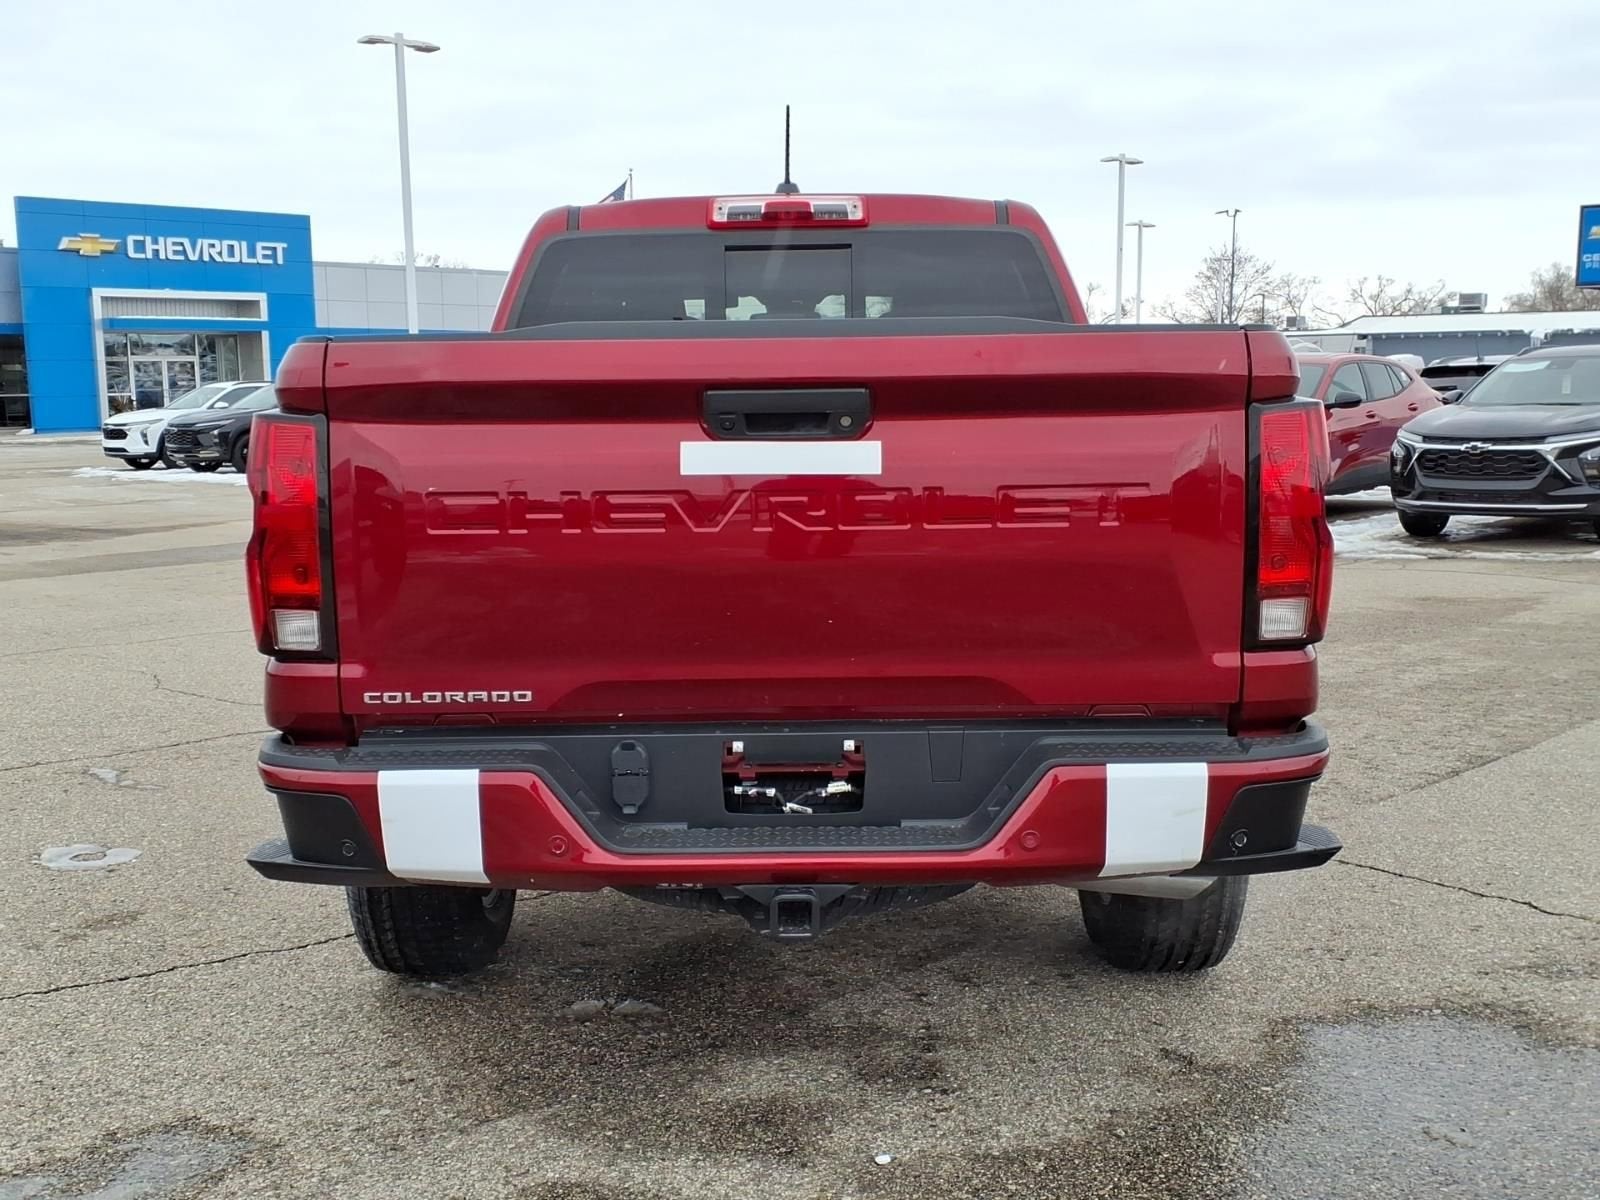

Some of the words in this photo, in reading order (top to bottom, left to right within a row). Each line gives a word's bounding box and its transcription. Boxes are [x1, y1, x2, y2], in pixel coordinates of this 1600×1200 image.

[126, 235, 288, 264] CHEVROLET
[424, 483, 1152, 535] CHEVROLET
[363, 691, 532, 704] COLORADO
